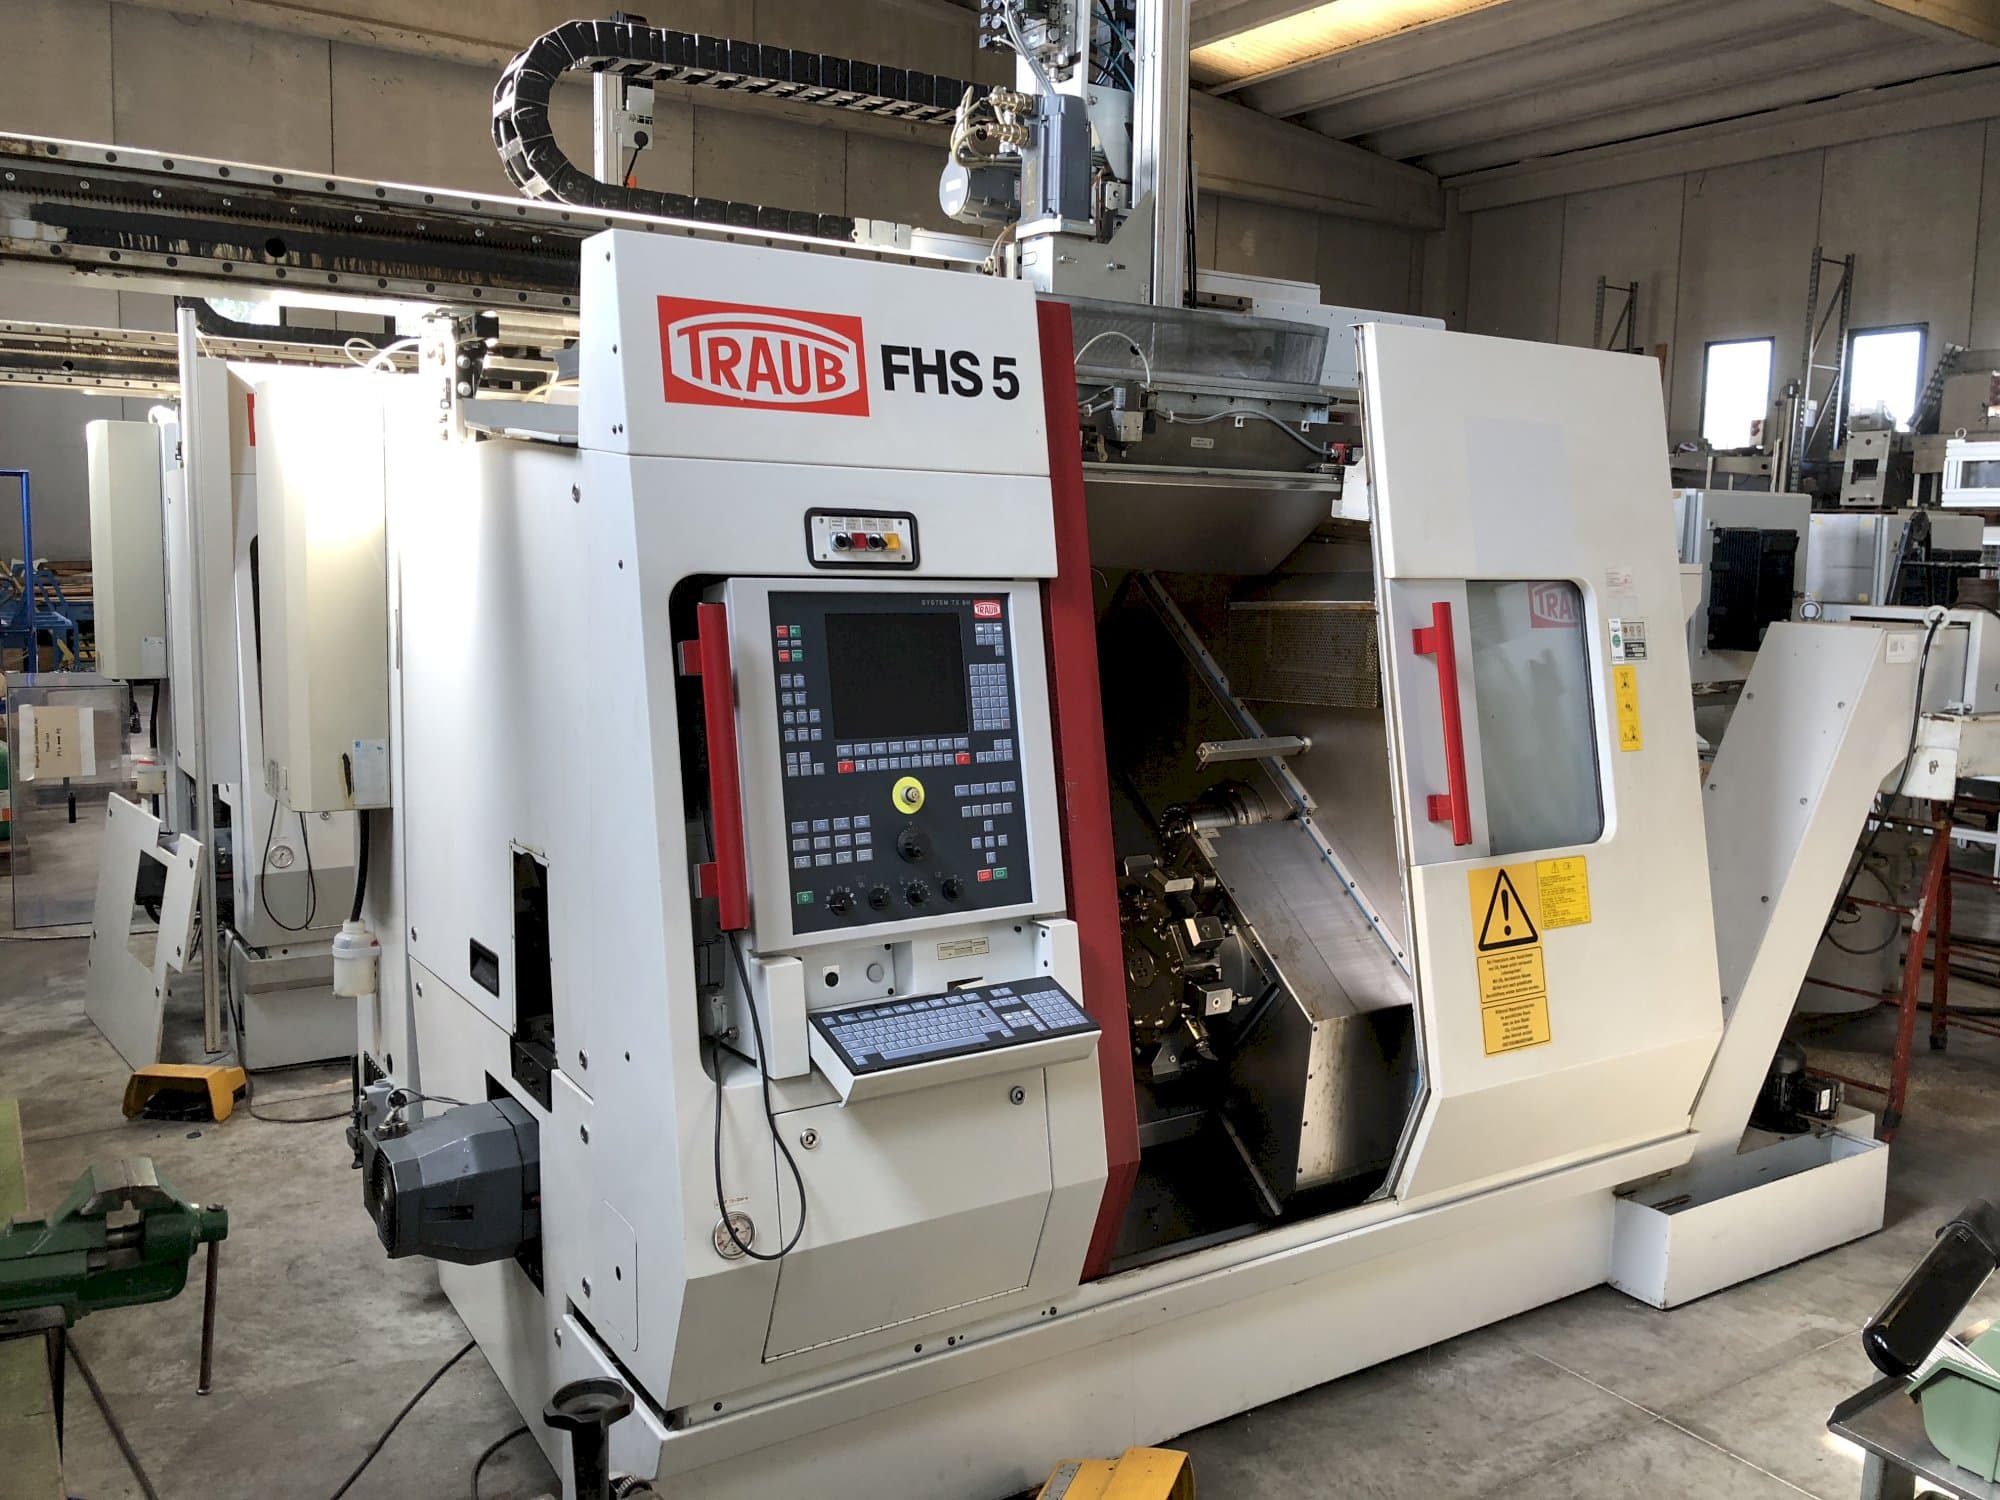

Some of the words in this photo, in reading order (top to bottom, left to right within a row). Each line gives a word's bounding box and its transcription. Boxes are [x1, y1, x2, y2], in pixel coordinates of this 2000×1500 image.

[677, 321, 850, 395] TRAUB
[880, 344, 984, 398] FHS
[992, 356, 1020, 400] 5
[975, 603, 1000, 615] TRAUB
[1534, 590, 1577, 620] TRA
